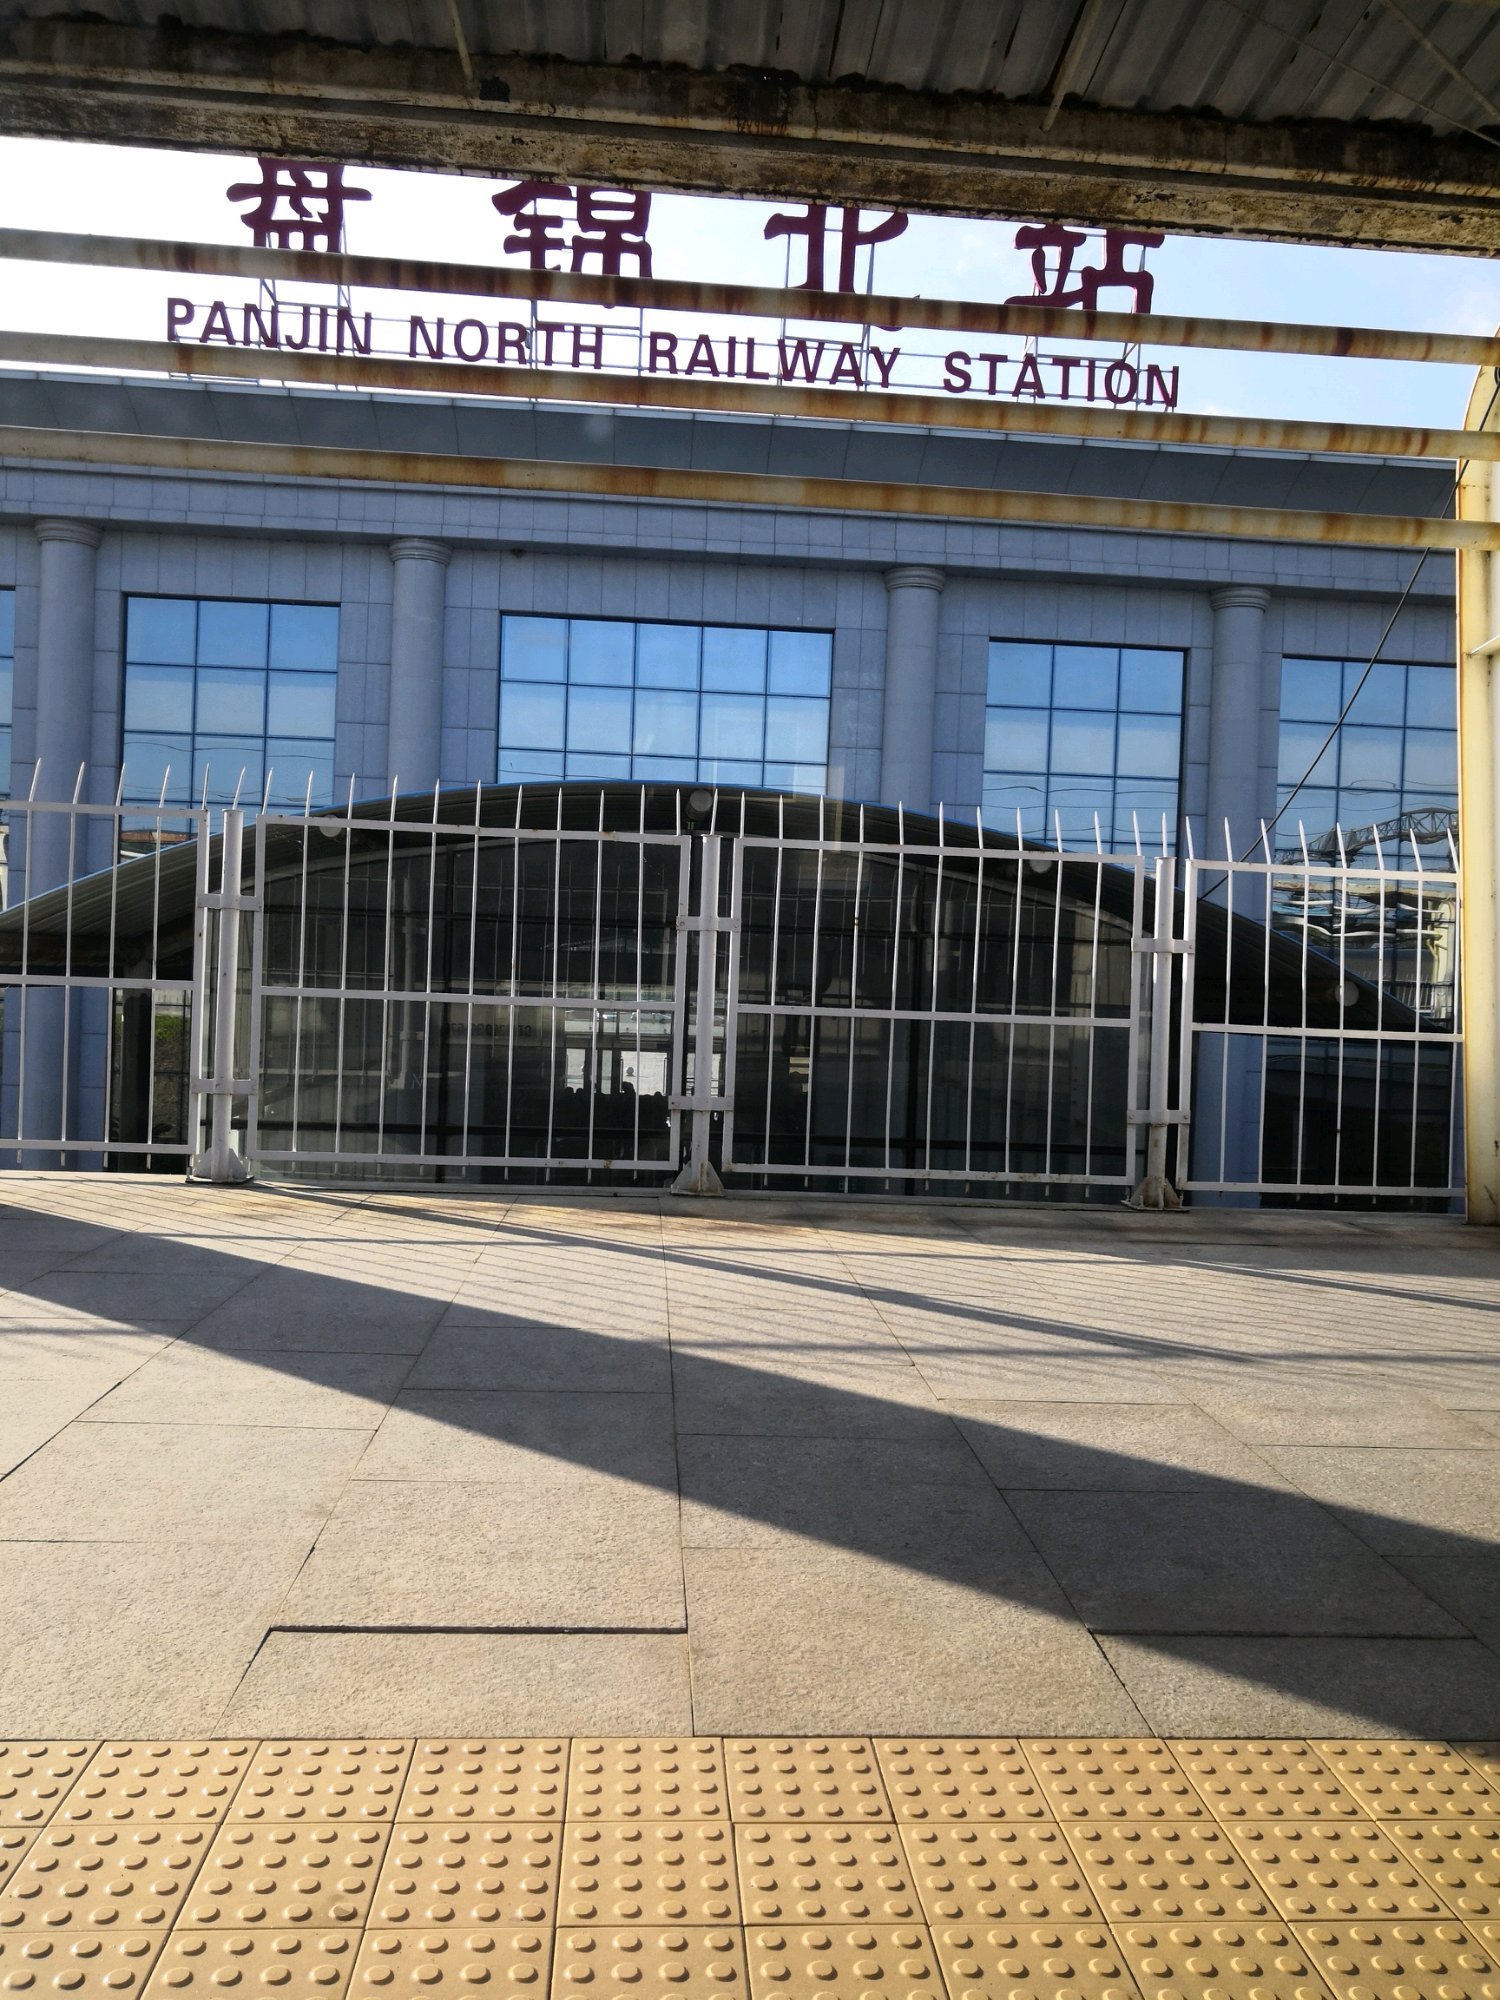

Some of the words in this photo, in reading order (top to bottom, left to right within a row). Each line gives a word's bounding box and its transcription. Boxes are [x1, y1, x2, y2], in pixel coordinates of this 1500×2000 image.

[167, 298, 372, 354] PANJIN
[410, 316, 602, 369] NORTH
[648, 331, 900, 388] RAILWAY
[943, 351, 1180, 408] STATION
